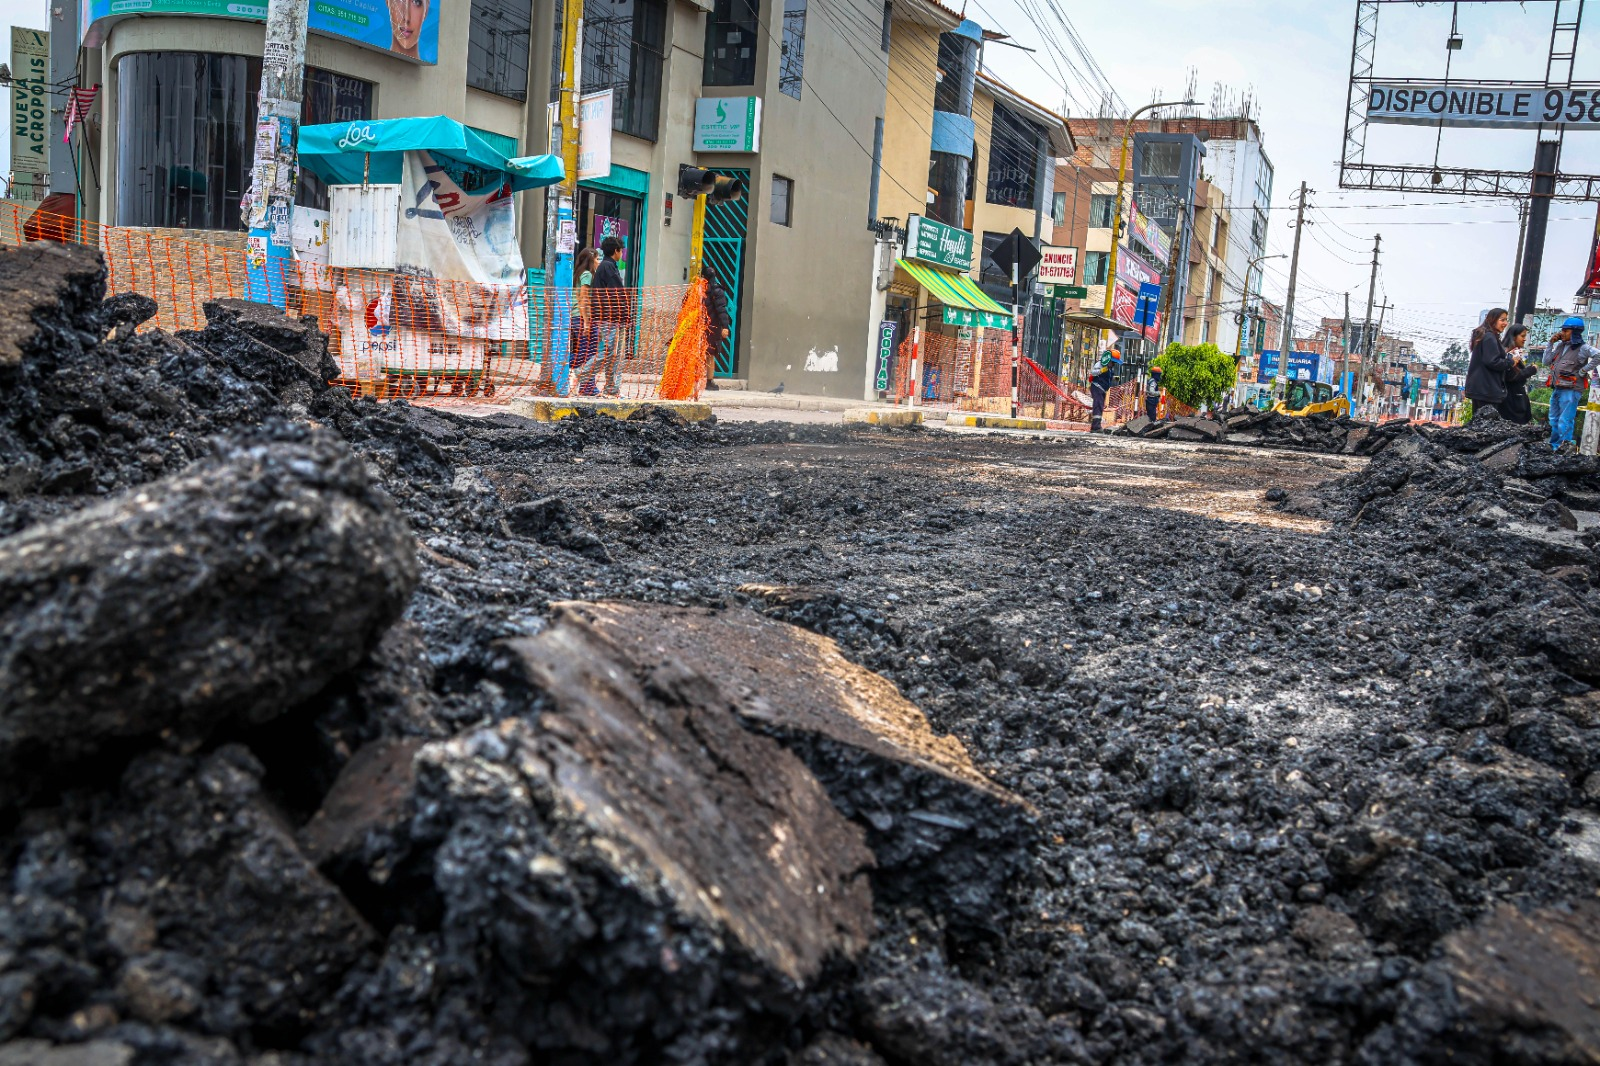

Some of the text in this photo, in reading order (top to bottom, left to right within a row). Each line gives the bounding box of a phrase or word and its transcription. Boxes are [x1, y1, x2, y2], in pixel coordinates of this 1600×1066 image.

[16, 78, 28, 137] NUEVA
[30, 58, 45, 155] ACROPOLIS
[1367, 88, 1532, 117] DISPONIBLE
[339, 122, 376, 148] Loa
[1044, 253, 1073, 264] ANUNCIE
[362, 339, 397, 353] pepsi
[877, 328, 893, 389] COPIAS
